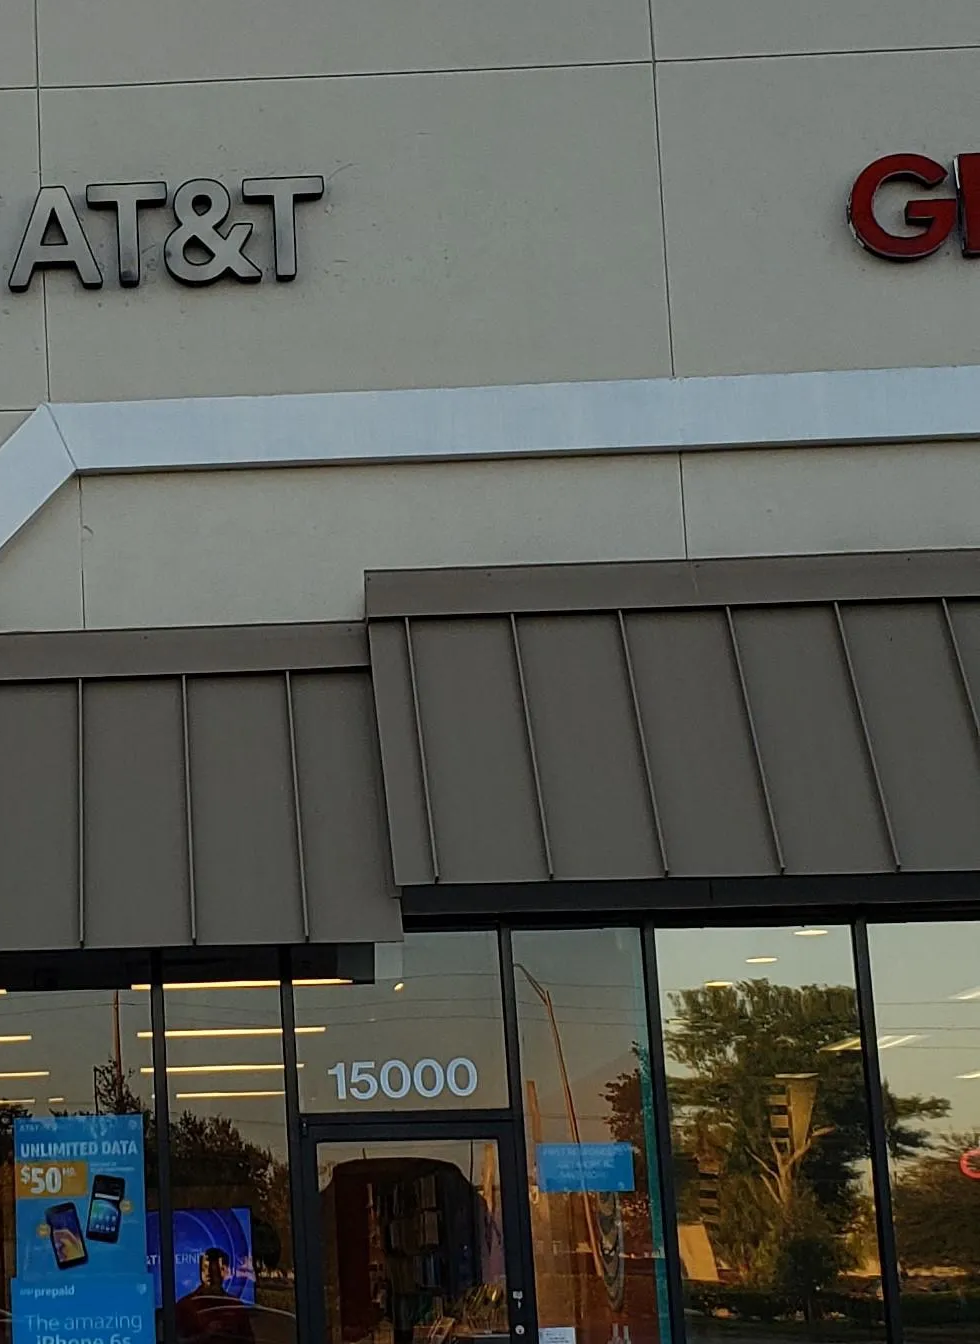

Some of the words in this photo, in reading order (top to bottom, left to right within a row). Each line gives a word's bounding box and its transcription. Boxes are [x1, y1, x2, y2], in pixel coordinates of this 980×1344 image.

[8, 175, 324, 293] AT&T
[327, 1057, 478, 1101] 15000
[20, 1141, 99, 1157] UNLIMITED
[102, 1139, 139, 1155] DATA
[21, 1164, 62, 1194] $50
[34, 1284, 75, 1299] prepaid
[24, 1313, 60, 1332] The
[64, 1312, 143, 1333] amazing
